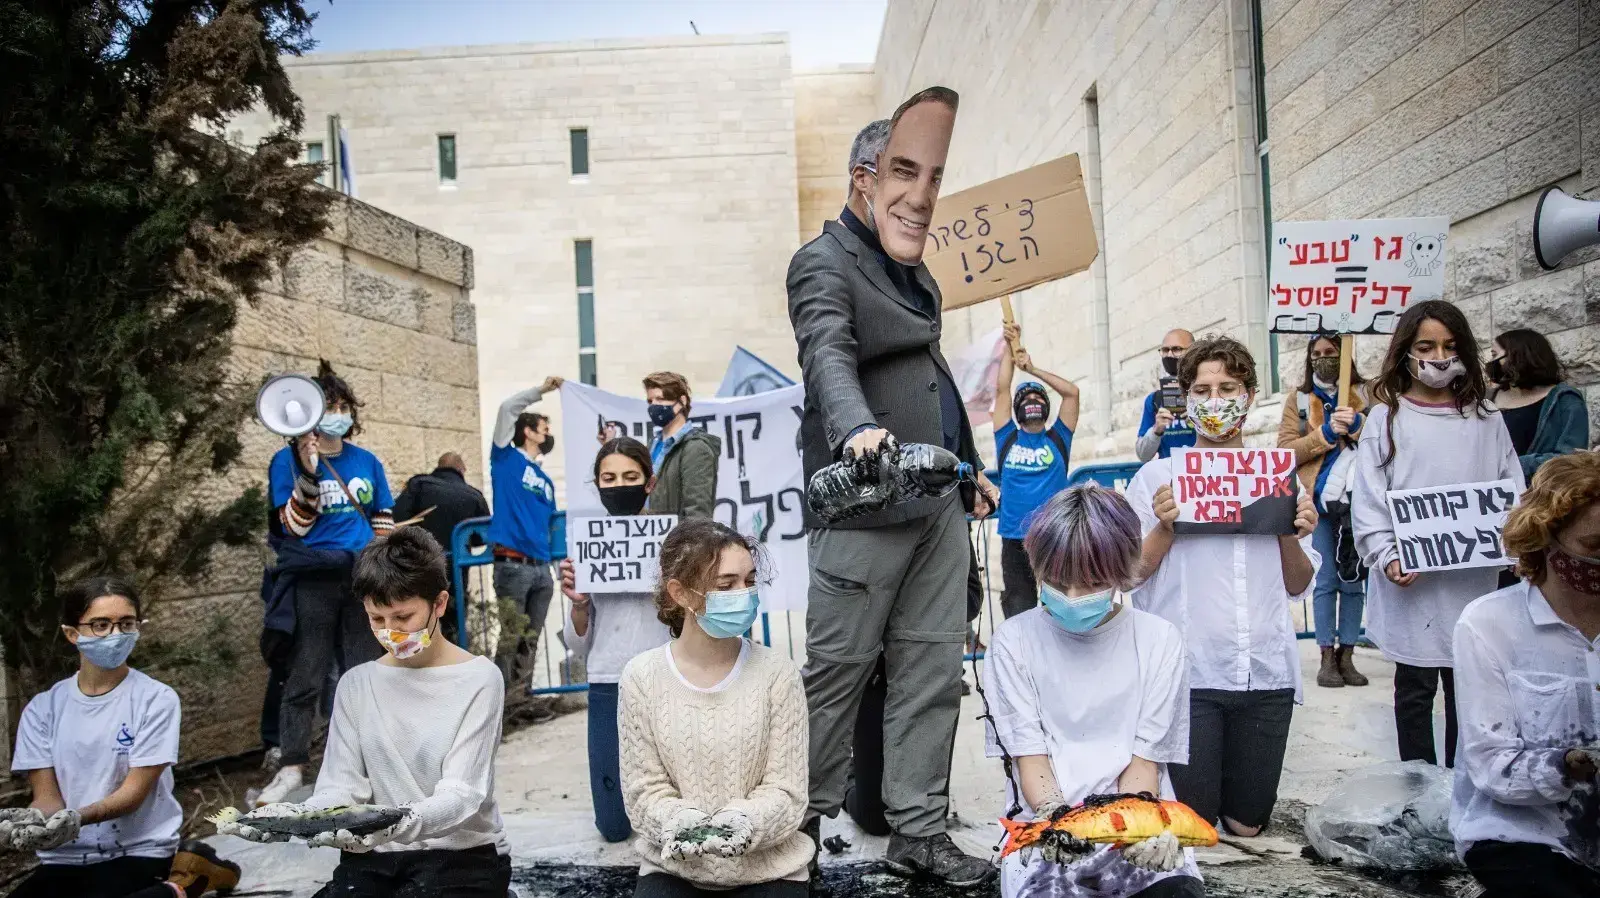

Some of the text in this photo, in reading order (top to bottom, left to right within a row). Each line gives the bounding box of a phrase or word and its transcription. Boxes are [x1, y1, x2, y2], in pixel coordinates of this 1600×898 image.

[961, 236, 1039, 284] הגז!
[1373, 236, 1403, 261] גז
[1350, 281, 1412, 314] דלק
[1185, 451, 1292, 476] עוצרים
[1177, 475, 1293, 503] את האסון
[1194, 500, 1242, 523] הבא
[1391, 486, 1515, 524] לא קודחים
[588, 518, 672, 538] עוצרים
[576, 540, 630, 564] האסון
[1399, 525, 1505, 570] פלמחים
[590, 561, 642, 582] הבא
